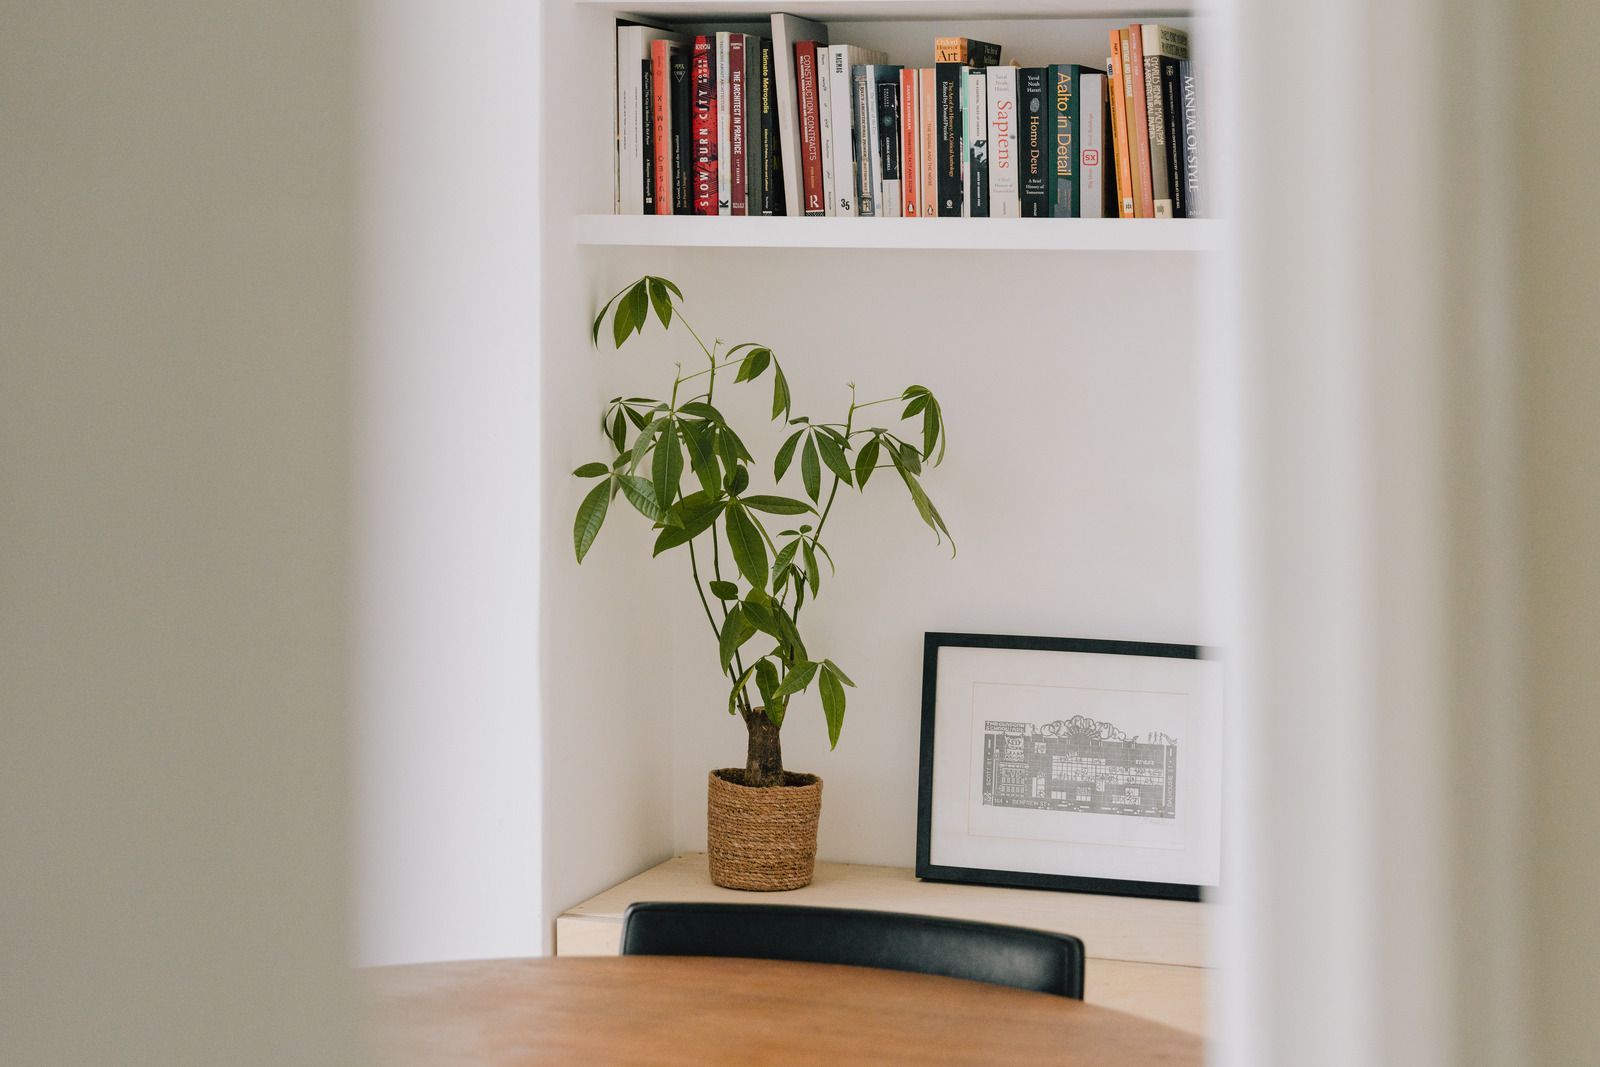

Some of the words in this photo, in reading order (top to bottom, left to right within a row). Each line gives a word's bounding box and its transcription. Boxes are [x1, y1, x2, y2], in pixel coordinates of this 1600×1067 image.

[936, 50, 958, 61] Art
[1151, 57, 1160, 83] CHARLES
[733, 83, 741, 116] ARCHITECT
[804, 55, 814, 114] CONSTRUCTION
[1057, 72, 1072, 111] Aalto
[1145, 69, 1154, 114] ARCHITECTURAL
[699, 89, 708, 120] CITY
[1184, 75, 1196, 133] MANUAL
[807, 116, 817, 161] CONTRACTS
[993, 100, 1013, 169] Sapiens
[1030, 116, 1039, 147] Homo
[1057, 115, 1071, 128] in
[699, 128, 708, 162] BURN
[1057, 133, 1072, 176] Detail
[1188, 135, 1196, 153] OF
[1031, 149, 1039, 174] Deus
[1188, 153, 1199, 192] STYLE
[700, 171, 708, 207] SLOW
[840, 198, 850, 211] 35
